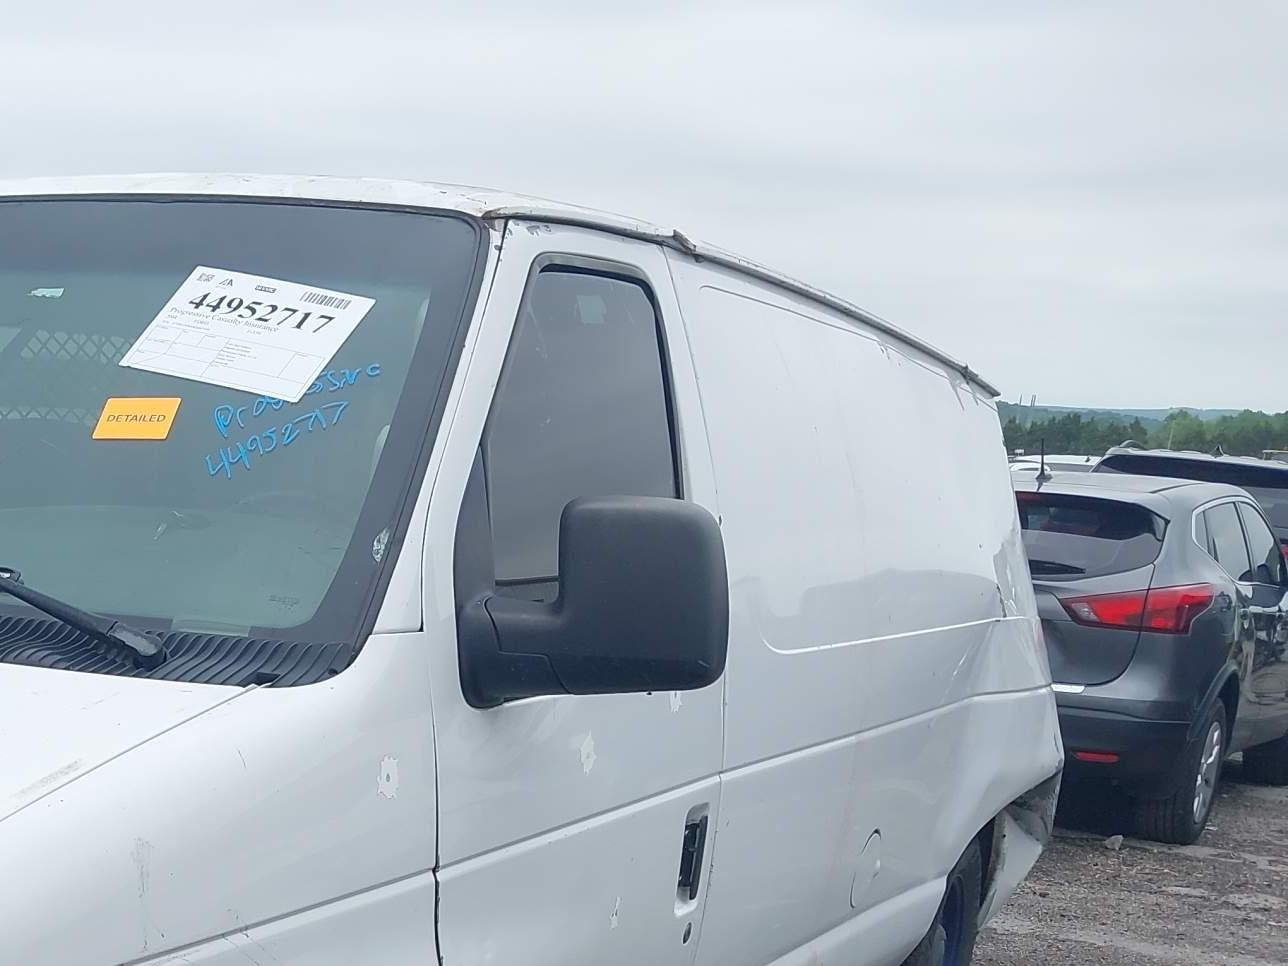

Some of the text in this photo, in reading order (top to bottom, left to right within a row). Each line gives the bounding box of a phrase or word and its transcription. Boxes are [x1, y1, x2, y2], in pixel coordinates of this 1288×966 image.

[188, 291, 336, 334] 44952717
[106, 414, 167, 423] DETAILED
[204, 401, 349, 480] 44952717
